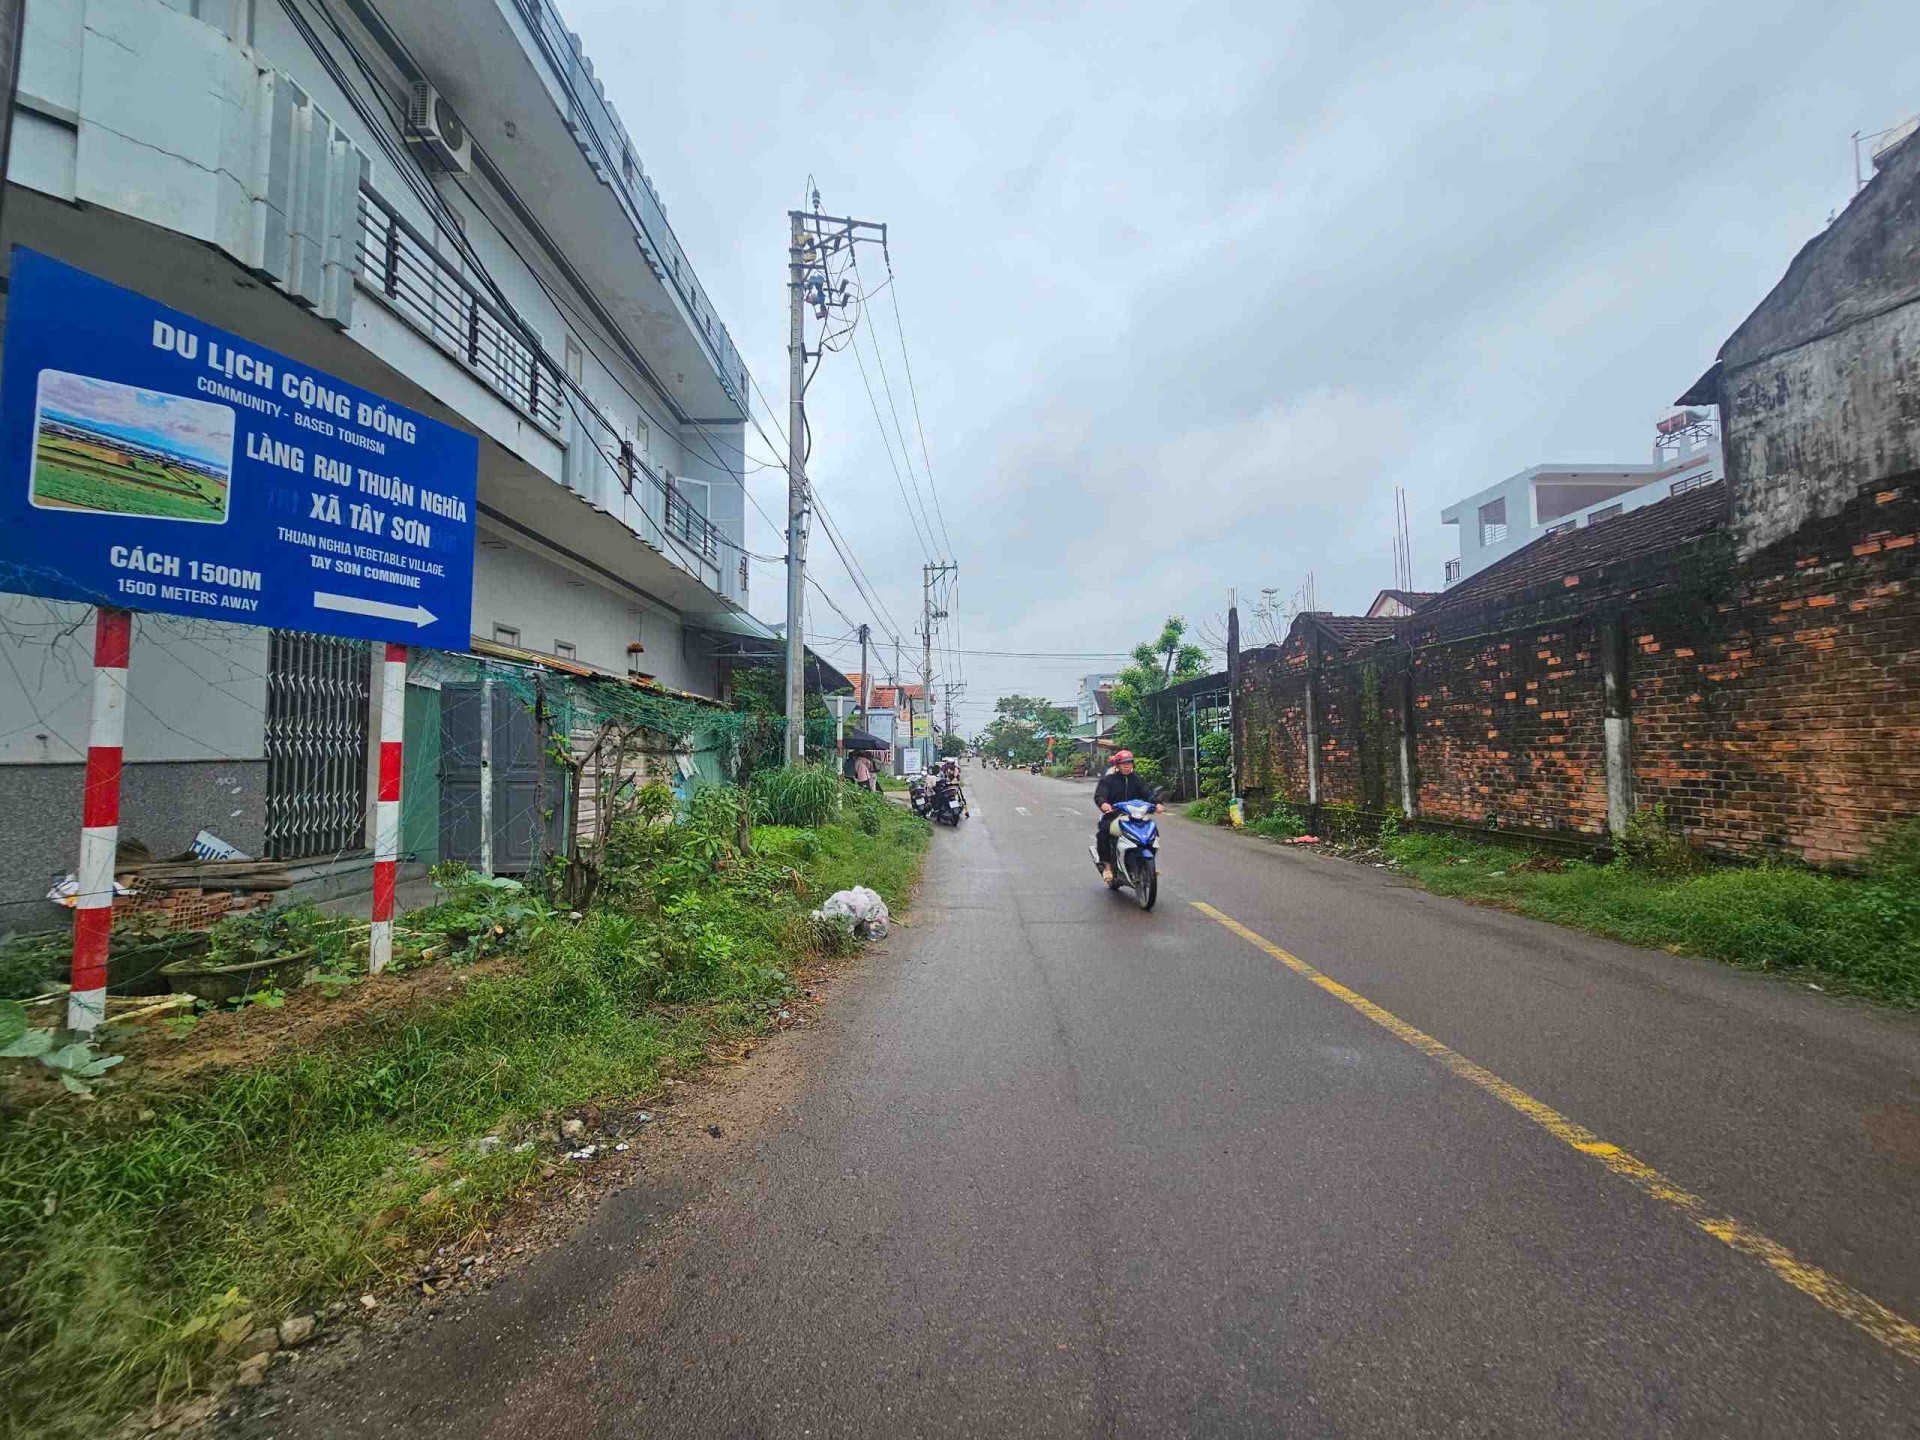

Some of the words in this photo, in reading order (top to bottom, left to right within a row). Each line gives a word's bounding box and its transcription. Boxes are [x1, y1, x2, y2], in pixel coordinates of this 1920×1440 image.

[152, 319, 198, 359] DU
[208, 341, 274, 390] LỊCH
[282, 373, 351, 419] CỘNG
[357, 402, 416, 444] ĐỒNG
[197, 376, 281, 418] COMMUNITY
[294, 411, 334, 437] BASED
[337, 427, 385, 455] TOURISM
[246, 432, 304, 473] LÀNG
[313, 453, 352, 487] RAU
[357, 468, 414, 506] THUẬN
[420, 489, 466, 523] NGHĨA
[309, 492, 342, 525] XÃ
[349, 503, 386, 535] TÂY
[390, 516, 431, 548] SƠN
[110, 545, 181, 577] CÁCH
[188, 560, 262, 591] 1500M
[277, 526, 317, 548] THUAN
[318, 536, 352, 556] NGHIA
[353, 544, 407, 568] VEGETABLE
[408, 557, 446, 578] VILLAGE,
[310, 554, 332, 570] TAY
[335, 560, 361, 576] SON
[363, 566, 421, 589] COMMUNE
[116, 578, 157, 597] 1500
[161, 584, 218, 606] METERS
[220, 595, 259, 612] AWAY
